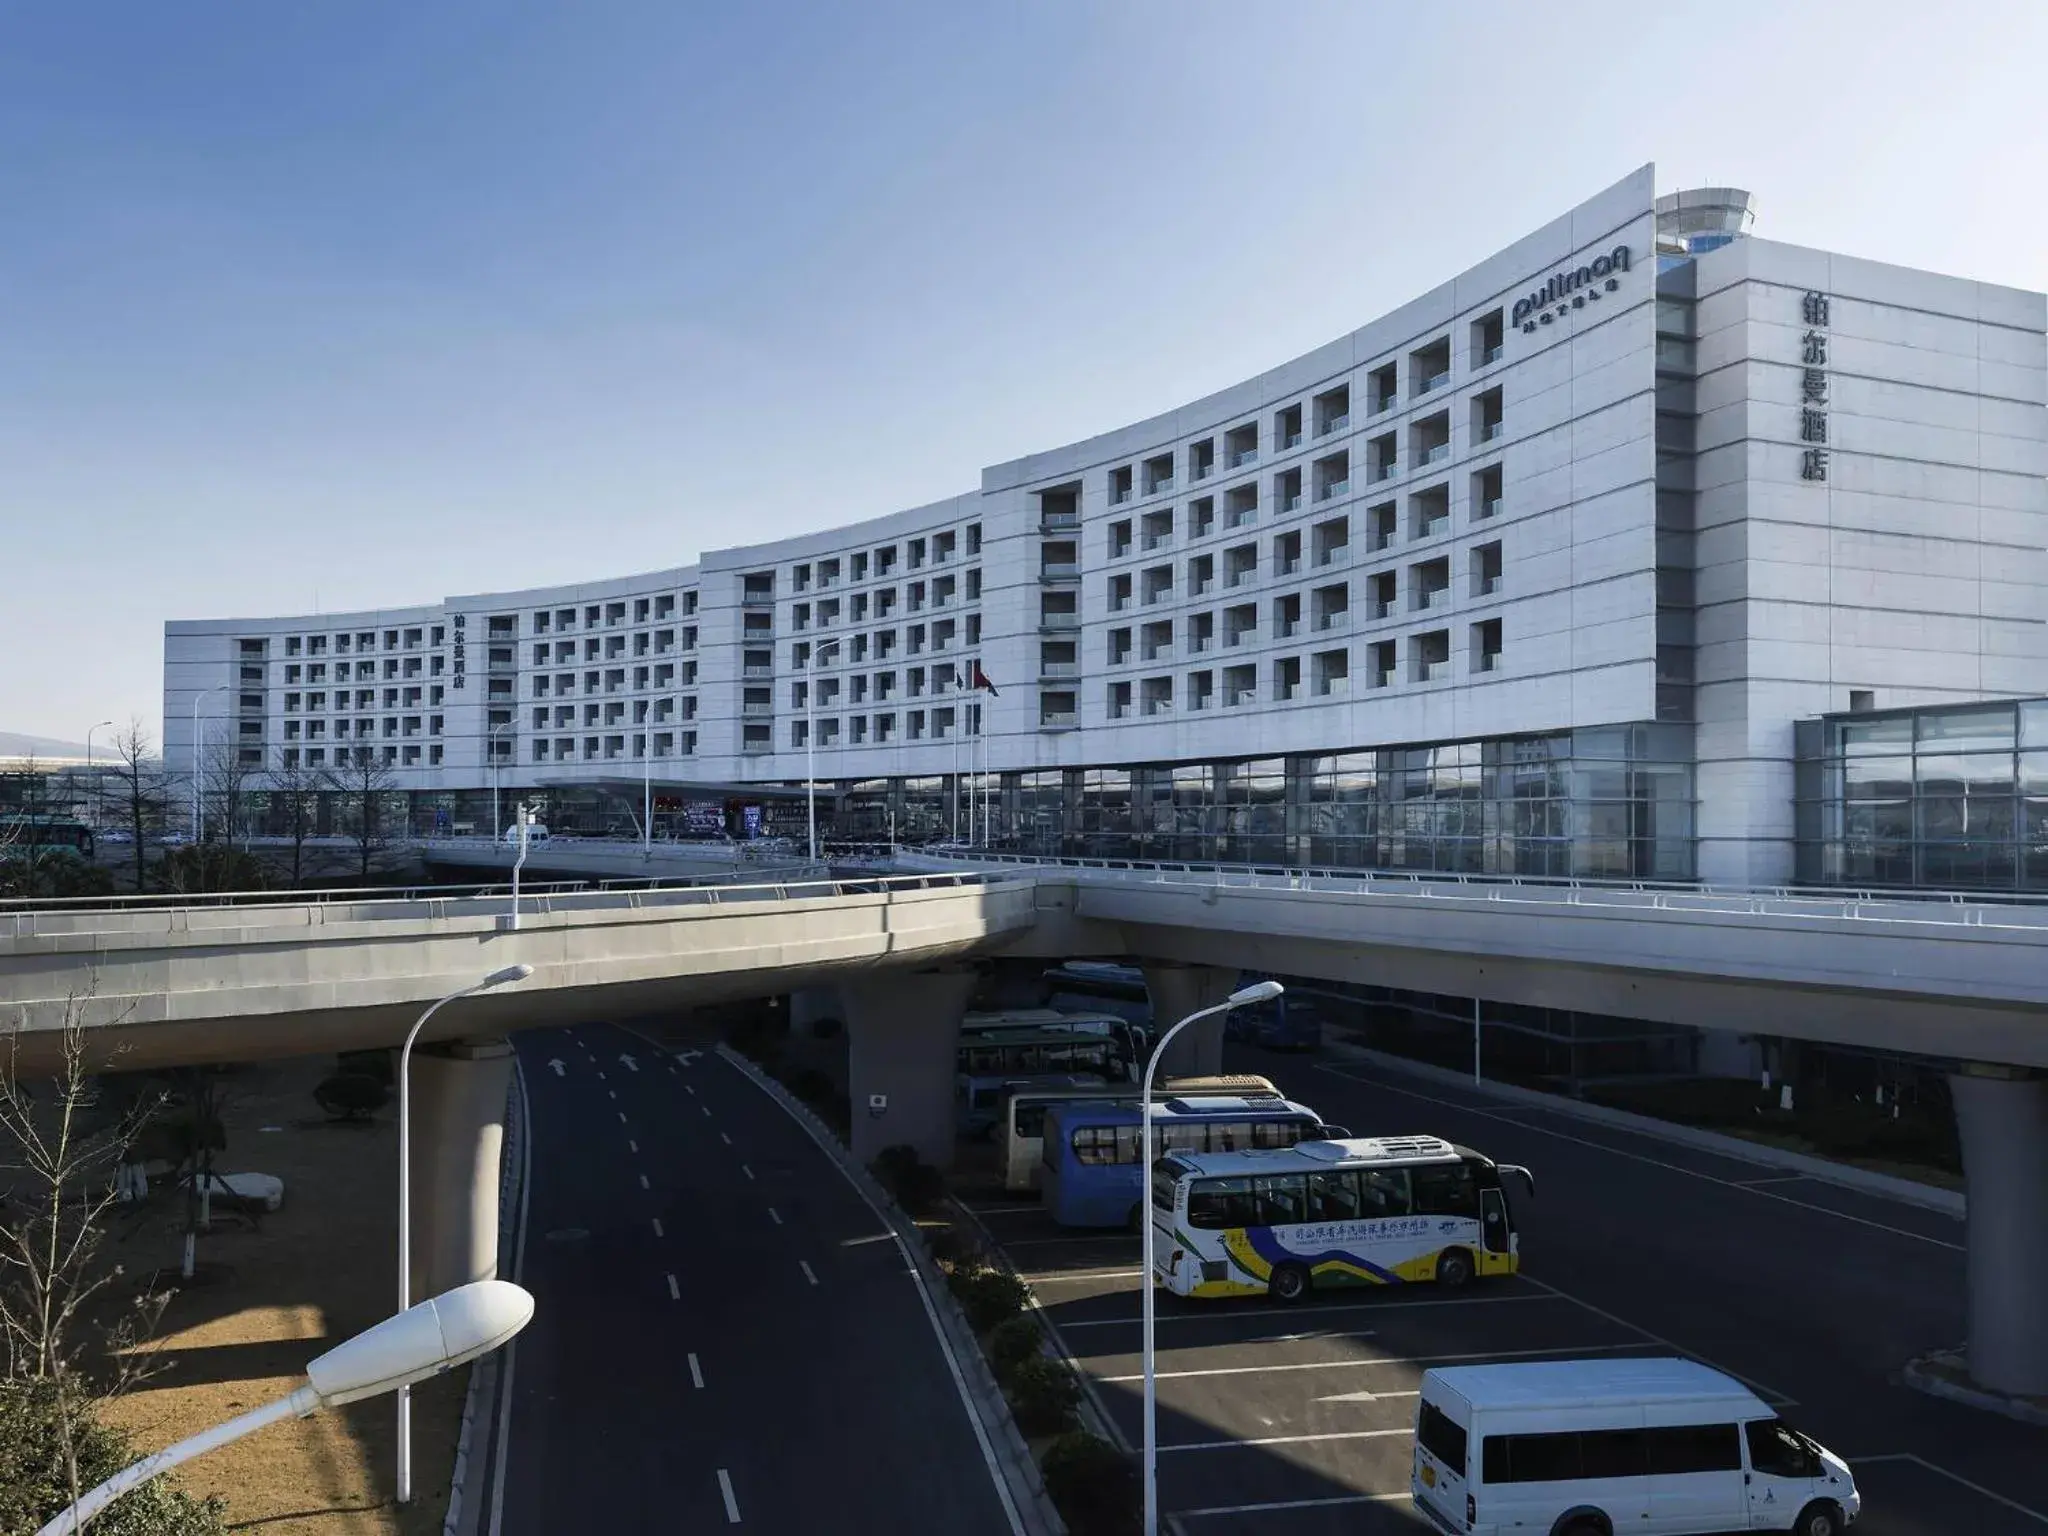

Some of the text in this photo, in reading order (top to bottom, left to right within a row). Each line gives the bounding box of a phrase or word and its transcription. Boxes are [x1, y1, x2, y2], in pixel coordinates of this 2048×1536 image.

[1512, 245, 1630, 328] pullman
[1801, 290, 1829, 481] 铂尔曼酒店
